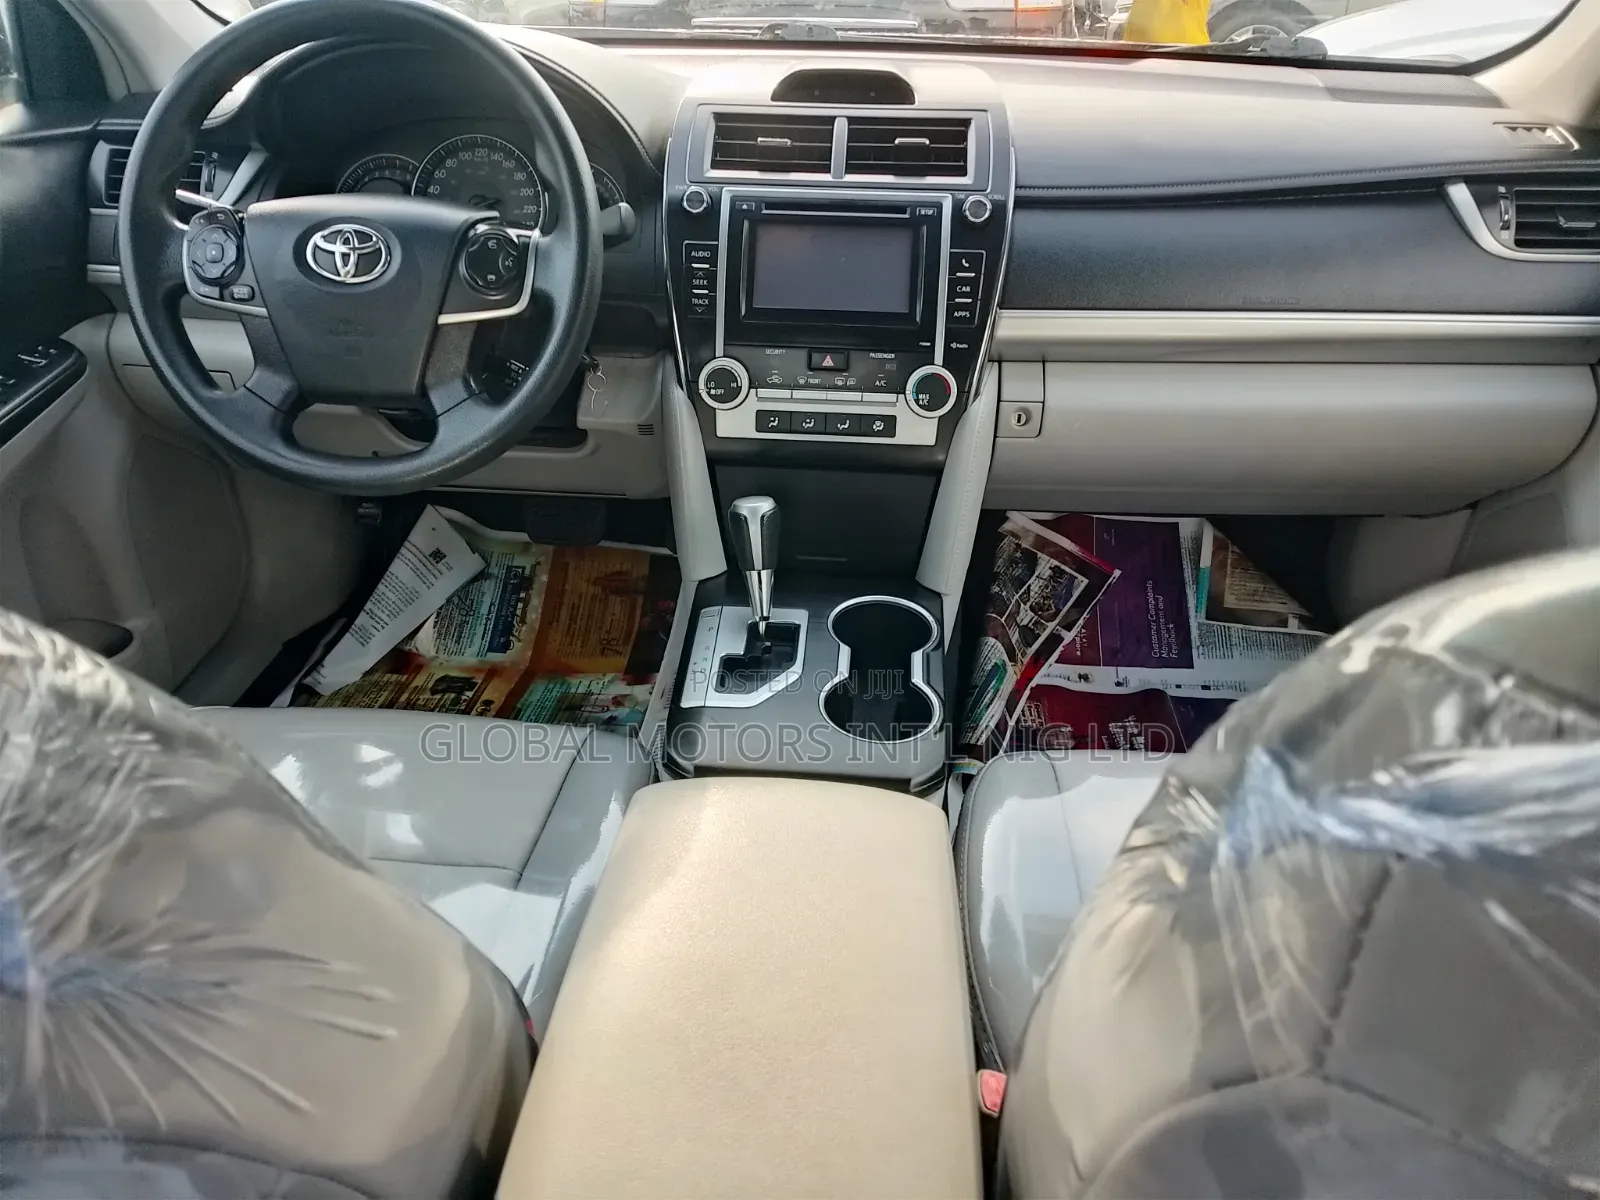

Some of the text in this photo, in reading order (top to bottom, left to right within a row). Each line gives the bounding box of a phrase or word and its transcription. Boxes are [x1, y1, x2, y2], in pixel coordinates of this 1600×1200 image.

[458, 152, 472, 160] 100
[475, 148, 488, 156] 120
[490, 152, 504, 161] 140
[445, 159, 457, 168] 80
[502, 160, 515, 169] 160
[433, 169, 446, 178] 60
[513, 172, 527, 180] 180
[427, 185, 440, 194] 40
[520, 188, 534, 196] 200
[522, 205, 537, 213] 220
[691, 250, 711, 258] AUDIO
[692, 278, 708, 286] SEEK
[1146, 580, 1160, 658] Customer Complaints
[1155, 595, 1169, 658] Management and
